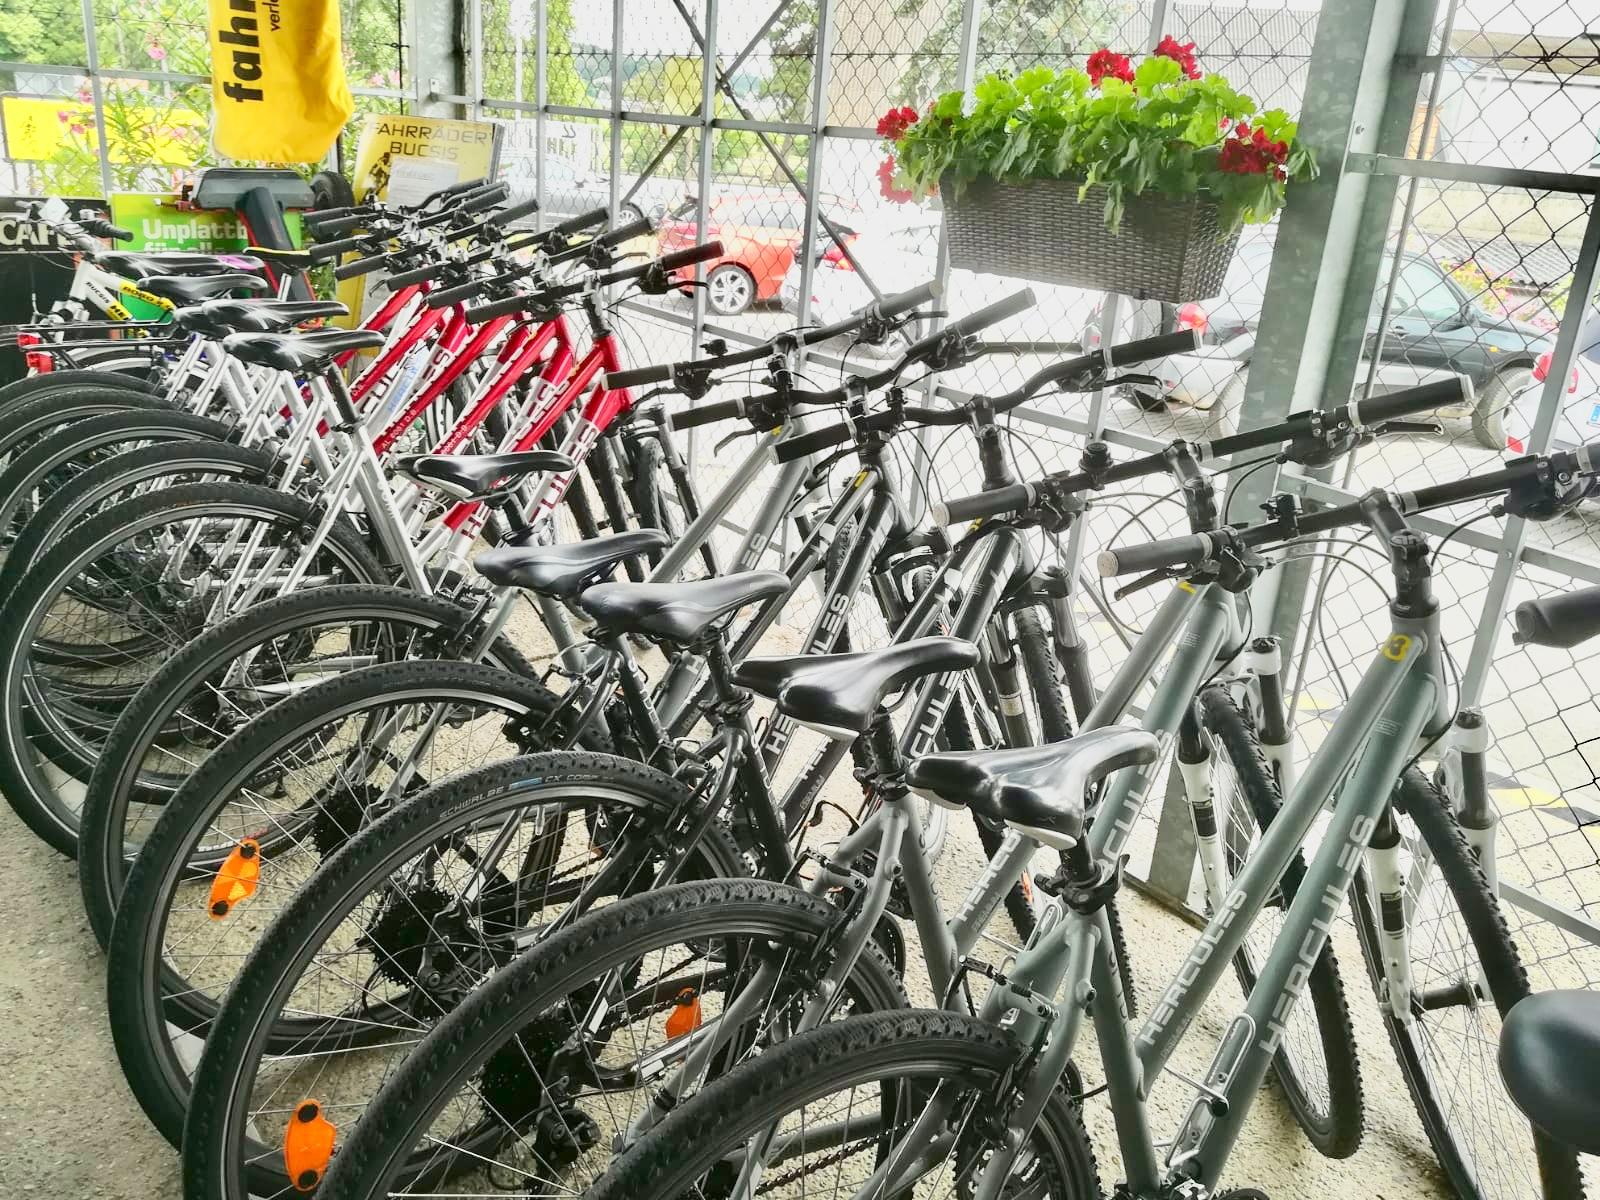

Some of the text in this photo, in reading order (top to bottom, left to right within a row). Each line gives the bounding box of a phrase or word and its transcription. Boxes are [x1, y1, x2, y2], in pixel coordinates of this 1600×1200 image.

[389, 141, 461, 160] BUCSIS
[1141, 890, 1247, 1046] HERCULES
[1258, 814, 1375, 1056] HERCULES
